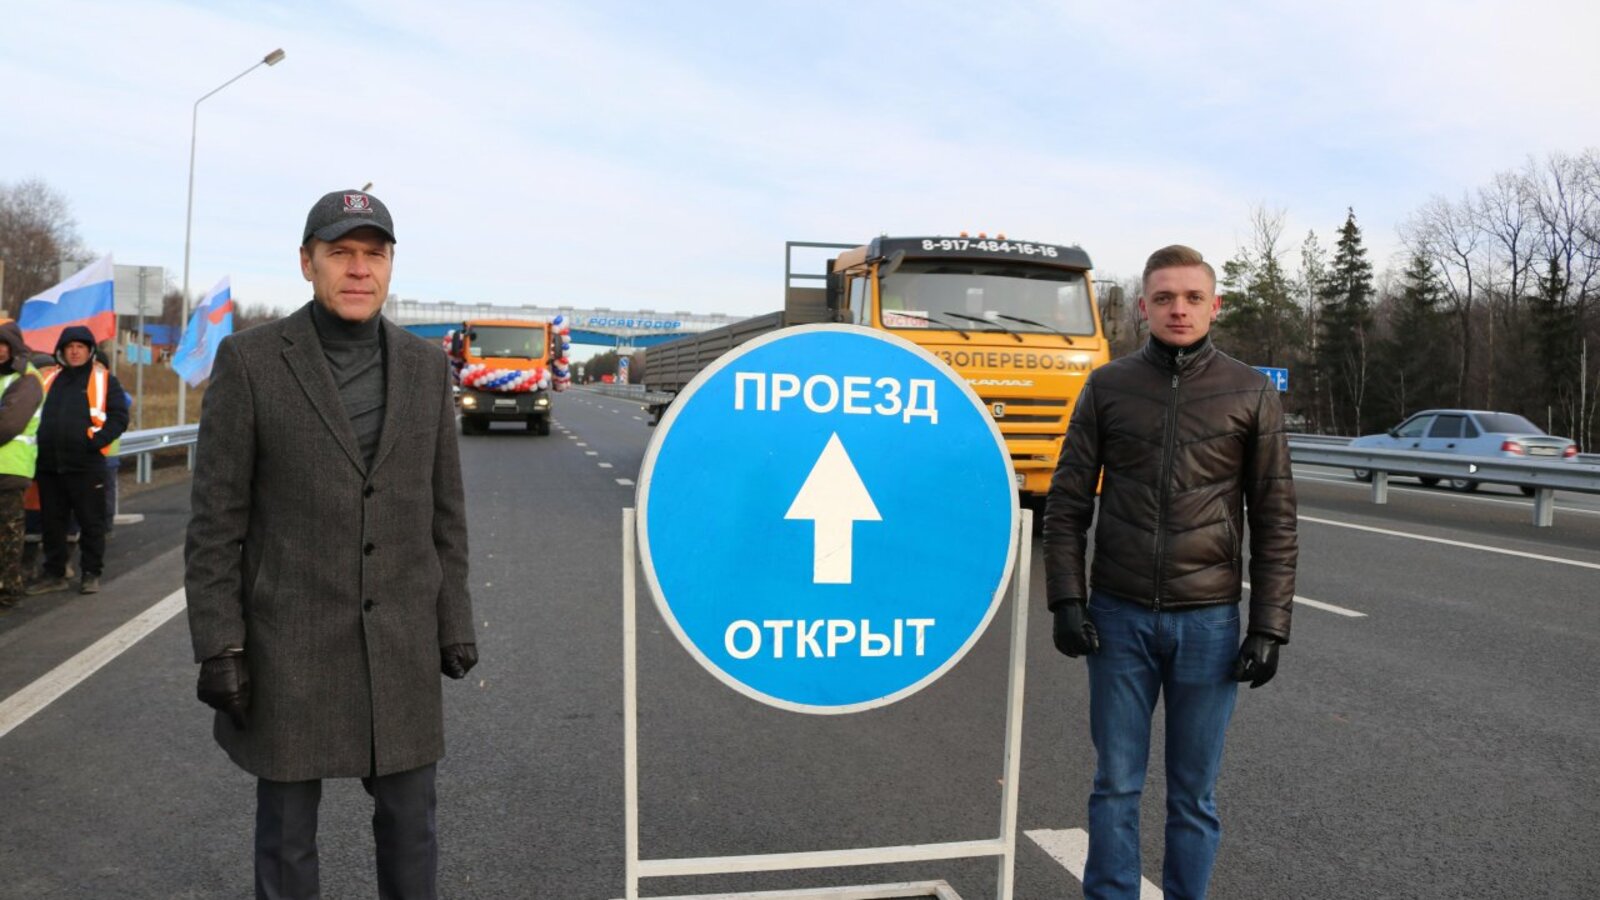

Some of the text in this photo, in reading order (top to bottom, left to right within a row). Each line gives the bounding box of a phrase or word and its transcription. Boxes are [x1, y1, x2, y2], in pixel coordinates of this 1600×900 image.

[922, 239, 1058, 257] 8-917-484-16-16
[589, 315, 682, 329] РОСАВТОДОР
[934, 351, 1093, 371] ЗОПЕРЕВОЗКИ
[734, 372, 938, 424] ПРОЕЗД
[724, 618, 935, 660] ОТКРЫТ
